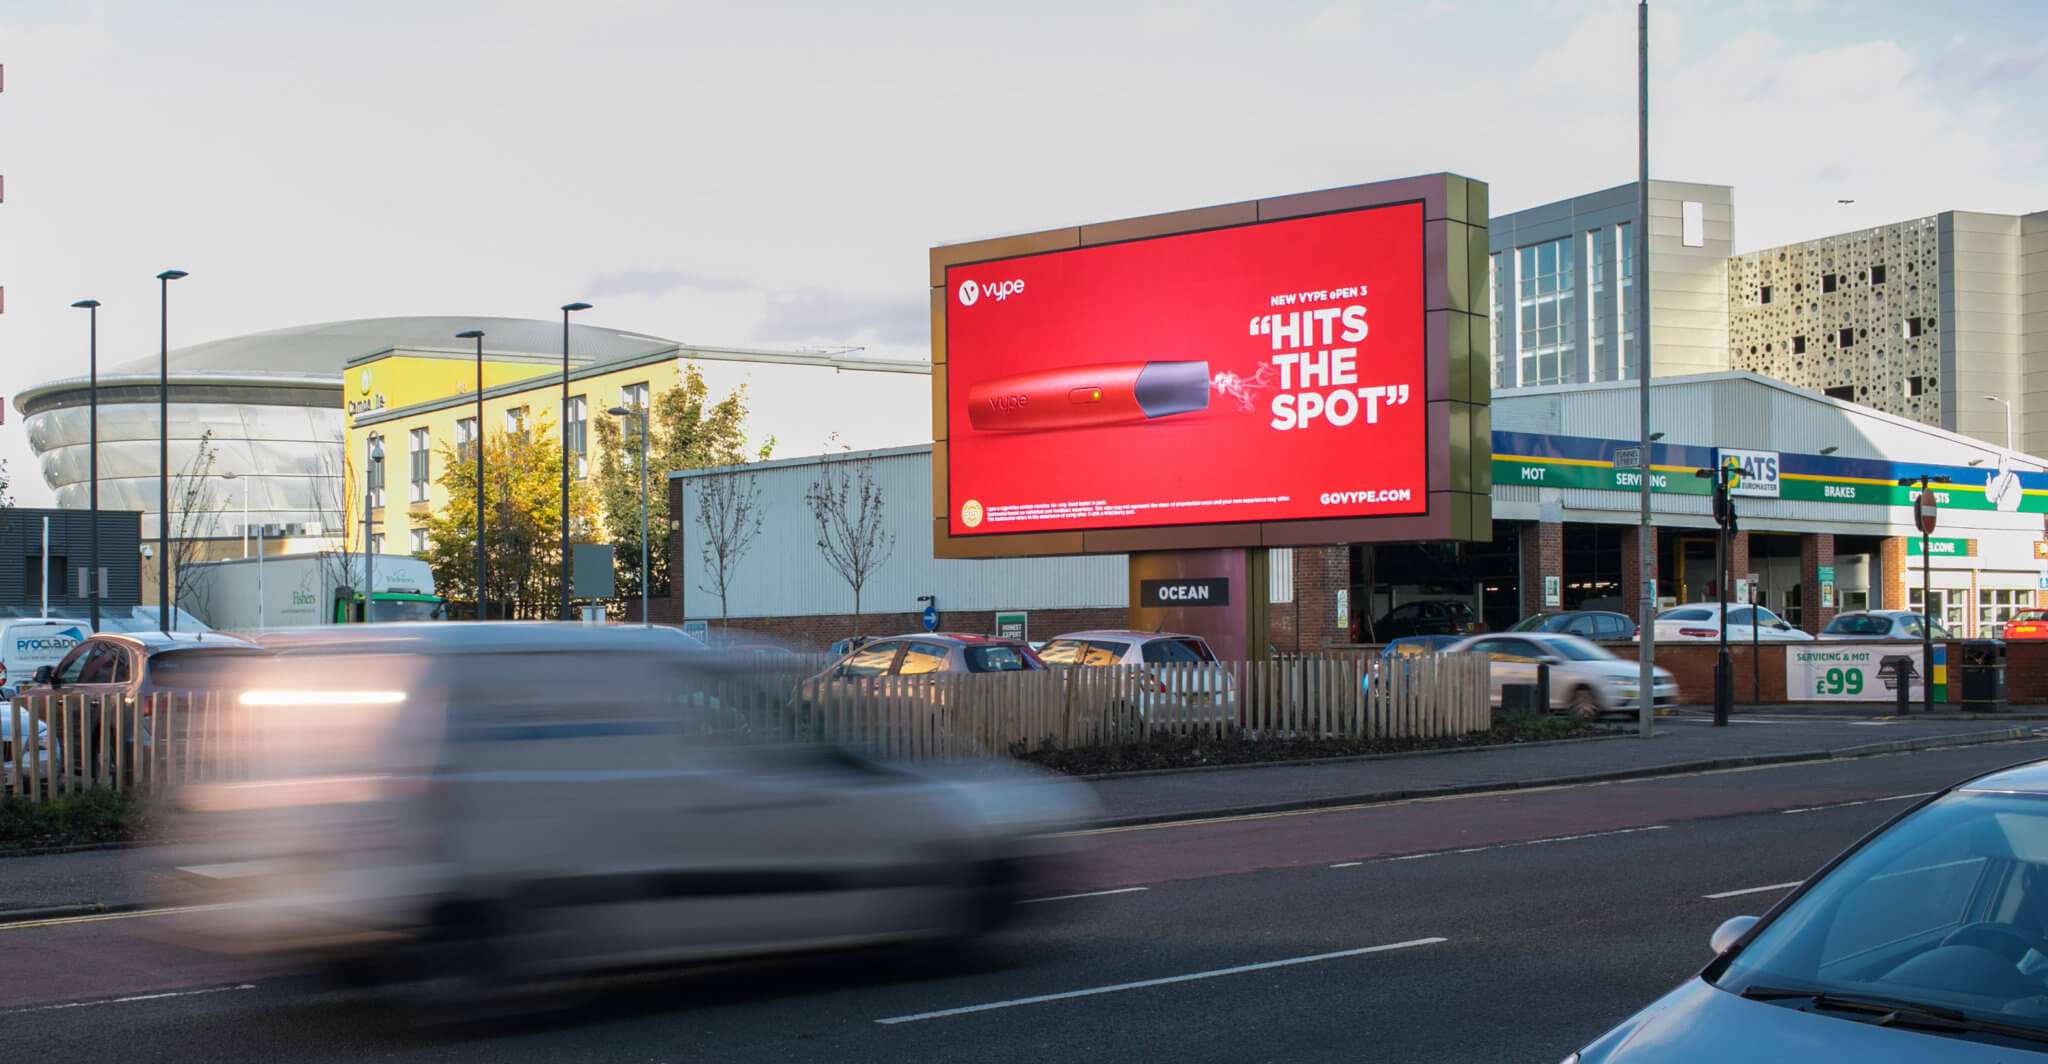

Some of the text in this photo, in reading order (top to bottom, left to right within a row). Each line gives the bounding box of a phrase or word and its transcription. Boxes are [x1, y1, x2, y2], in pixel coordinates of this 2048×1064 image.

[982, 279, 1024, 301] vype
[1270, 285, 1368, 306] NEW VYPE ePEN 3
[1272, 347, 1358, 390] THE
[988, 395, 1029, 413] vype
[1521, 467, 1546, 480] MOT
[1742, 455, 1777, 482] ATS
[1616, 473, 1667, 488] SERVIING
[1320, 488, 1411, 505] GOVYPE.COM
[1824, 485, 1856, 498] BRAKES
[1158, 585, 1209, 600] OCEAN
[1797, 653, 1841, 662] SERVICING
